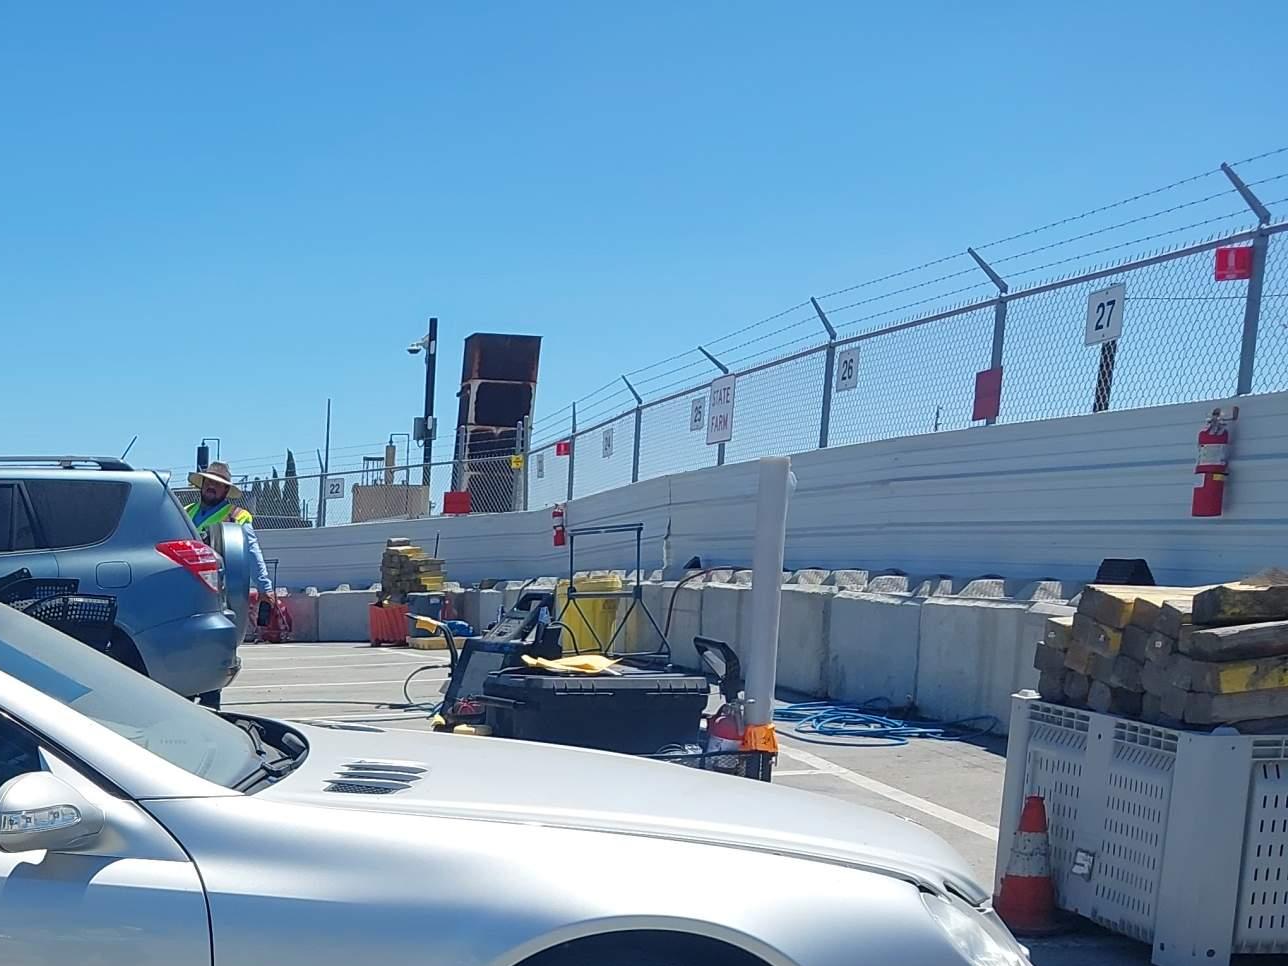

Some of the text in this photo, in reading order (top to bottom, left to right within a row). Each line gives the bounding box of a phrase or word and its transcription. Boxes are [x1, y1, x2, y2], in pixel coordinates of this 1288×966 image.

[1094, 299, 1116, 331] 27
[841, 358, 854, 381] 26
[712, 386, 731, 407] STATE
[694, 405, 702, 423] 25
[711, 413, 729, 433] FARM
[329, 483, 341, 495] 22
